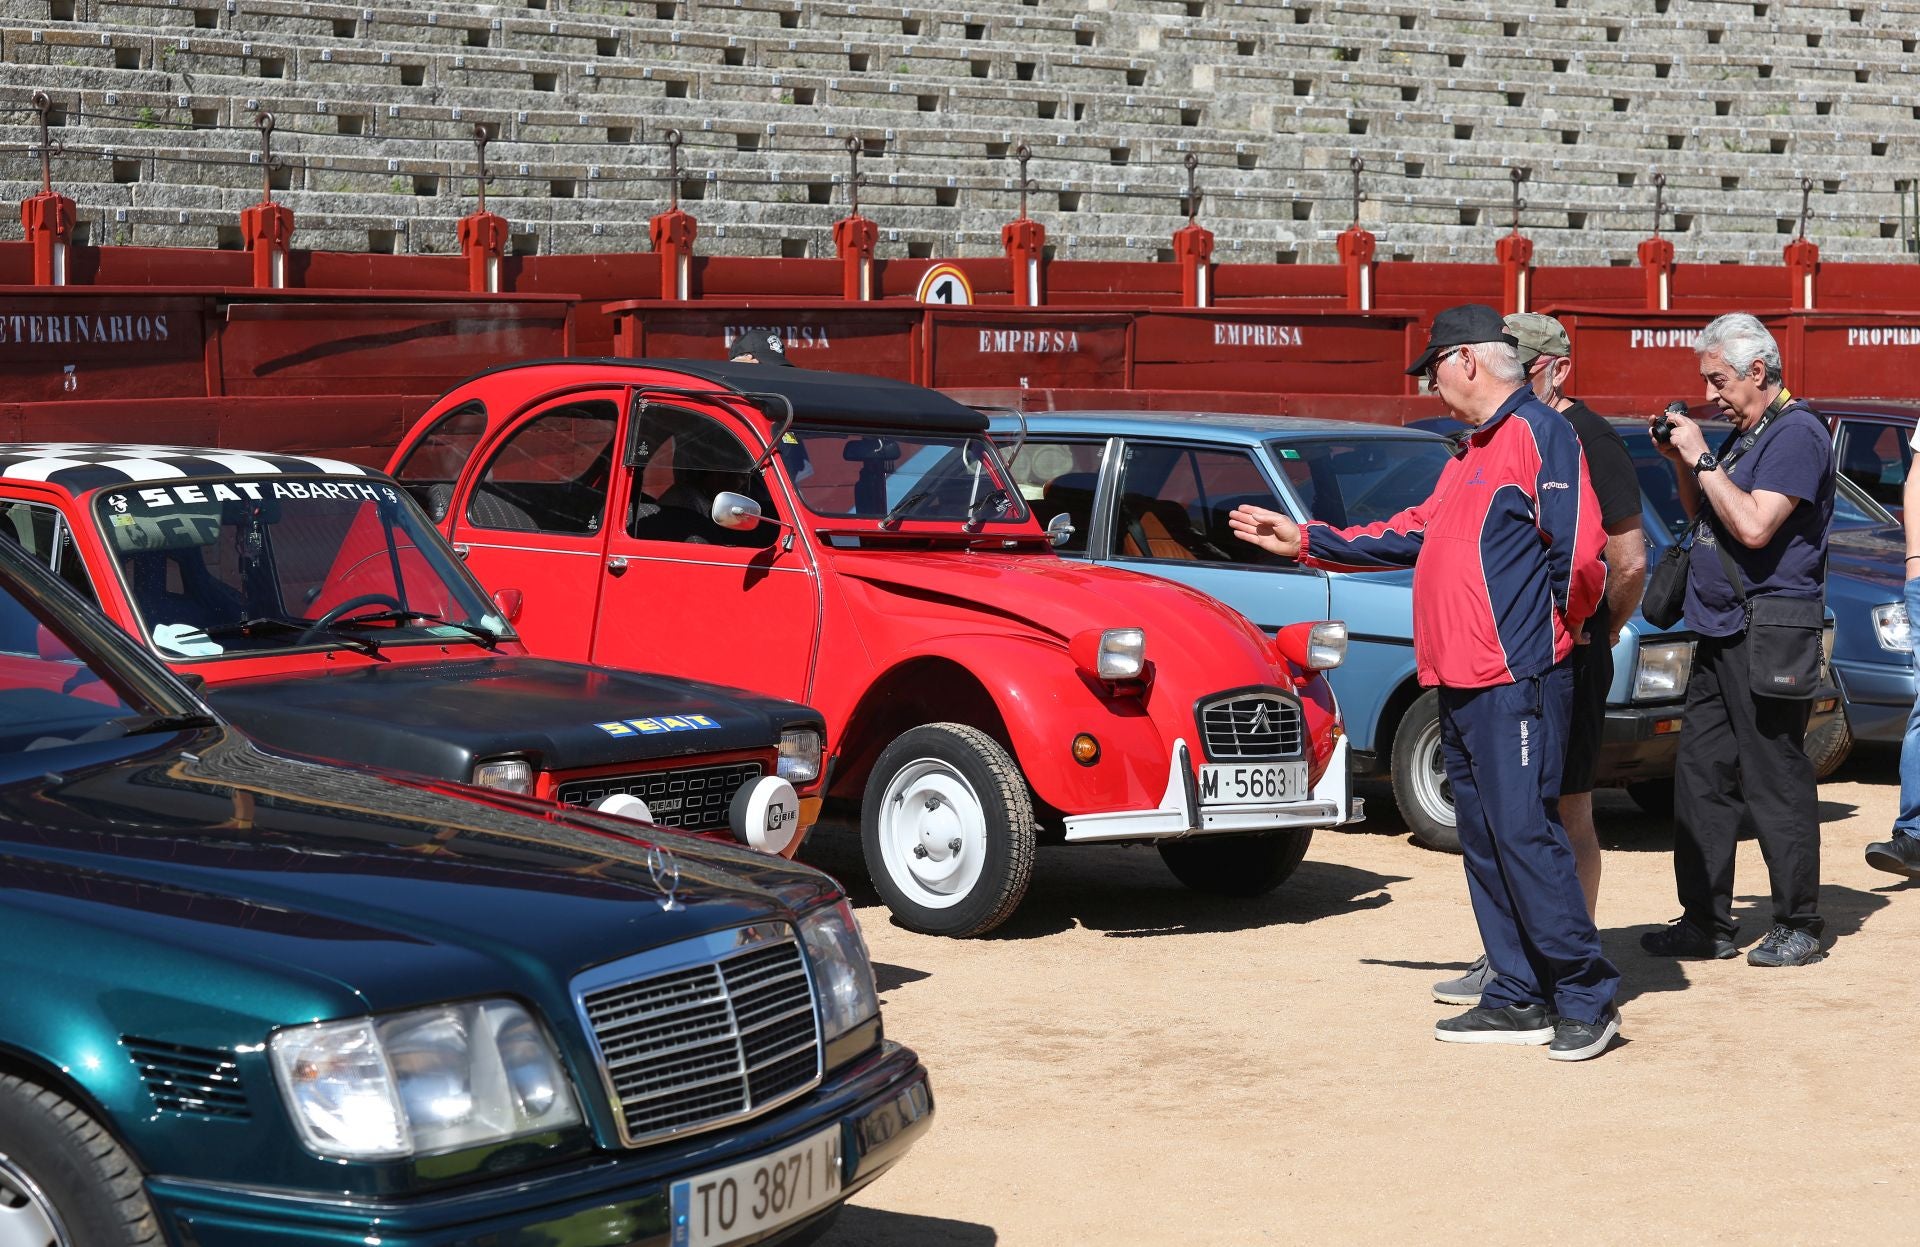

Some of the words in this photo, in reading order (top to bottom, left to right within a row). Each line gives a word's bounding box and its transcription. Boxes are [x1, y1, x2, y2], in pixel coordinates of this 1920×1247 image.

[936, 281, 952, 304] 1
[724, 325, 830, 349] EESA
[979, 330, 1079, 353] EMPRESA
[1214, 324, 1303, 346] EMPRESA
[1631, 328, 1703, 348] PROPIE
[137, 482, 264, 508] SEAT
[272, 482, 381, 501] ABARTH
[598, 715, 712, 735] SEAT
[1235, 768, 1286, 798] 5663
[649, 798, 682, 812] SEAT
[697, 1177, 738, 1238] TO
[752, 1147, 814, 1220] 3871
